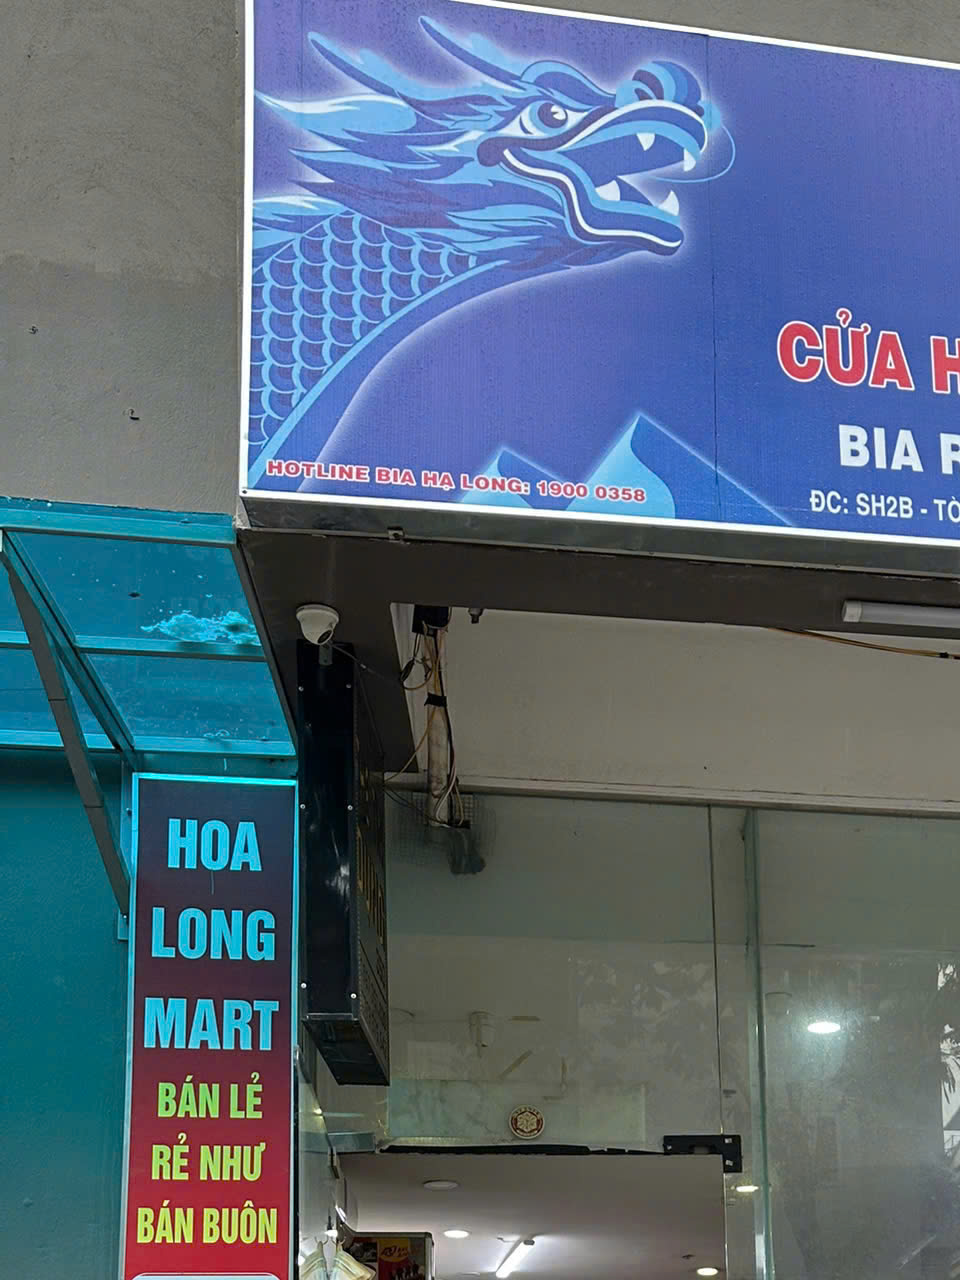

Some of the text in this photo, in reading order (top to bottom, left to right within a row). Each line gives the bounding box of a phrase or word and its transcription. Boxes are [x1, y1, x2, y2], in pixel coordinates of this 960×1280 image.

[776, 308, 915, 392] CỬA
[838, 423, 924, 473] BIA
[265, 459, 648, 504] HOTLINE BIA HẠ LONG: 1900 0358
[808, 488, 850, 516] ĐC:
[855, 492, 914, 519] SH2B
[166, 818, 263, 872] HOA
[151, 906, 276, 962] LONG
[143, 996, 280, 1051] MART
[156, 1070, 263, 1120] BÁN LẺ
[151, 1132, 266, 1182] RẺ NHƯ
[136, 1199, 277, 1245] BÁN BUÔN
